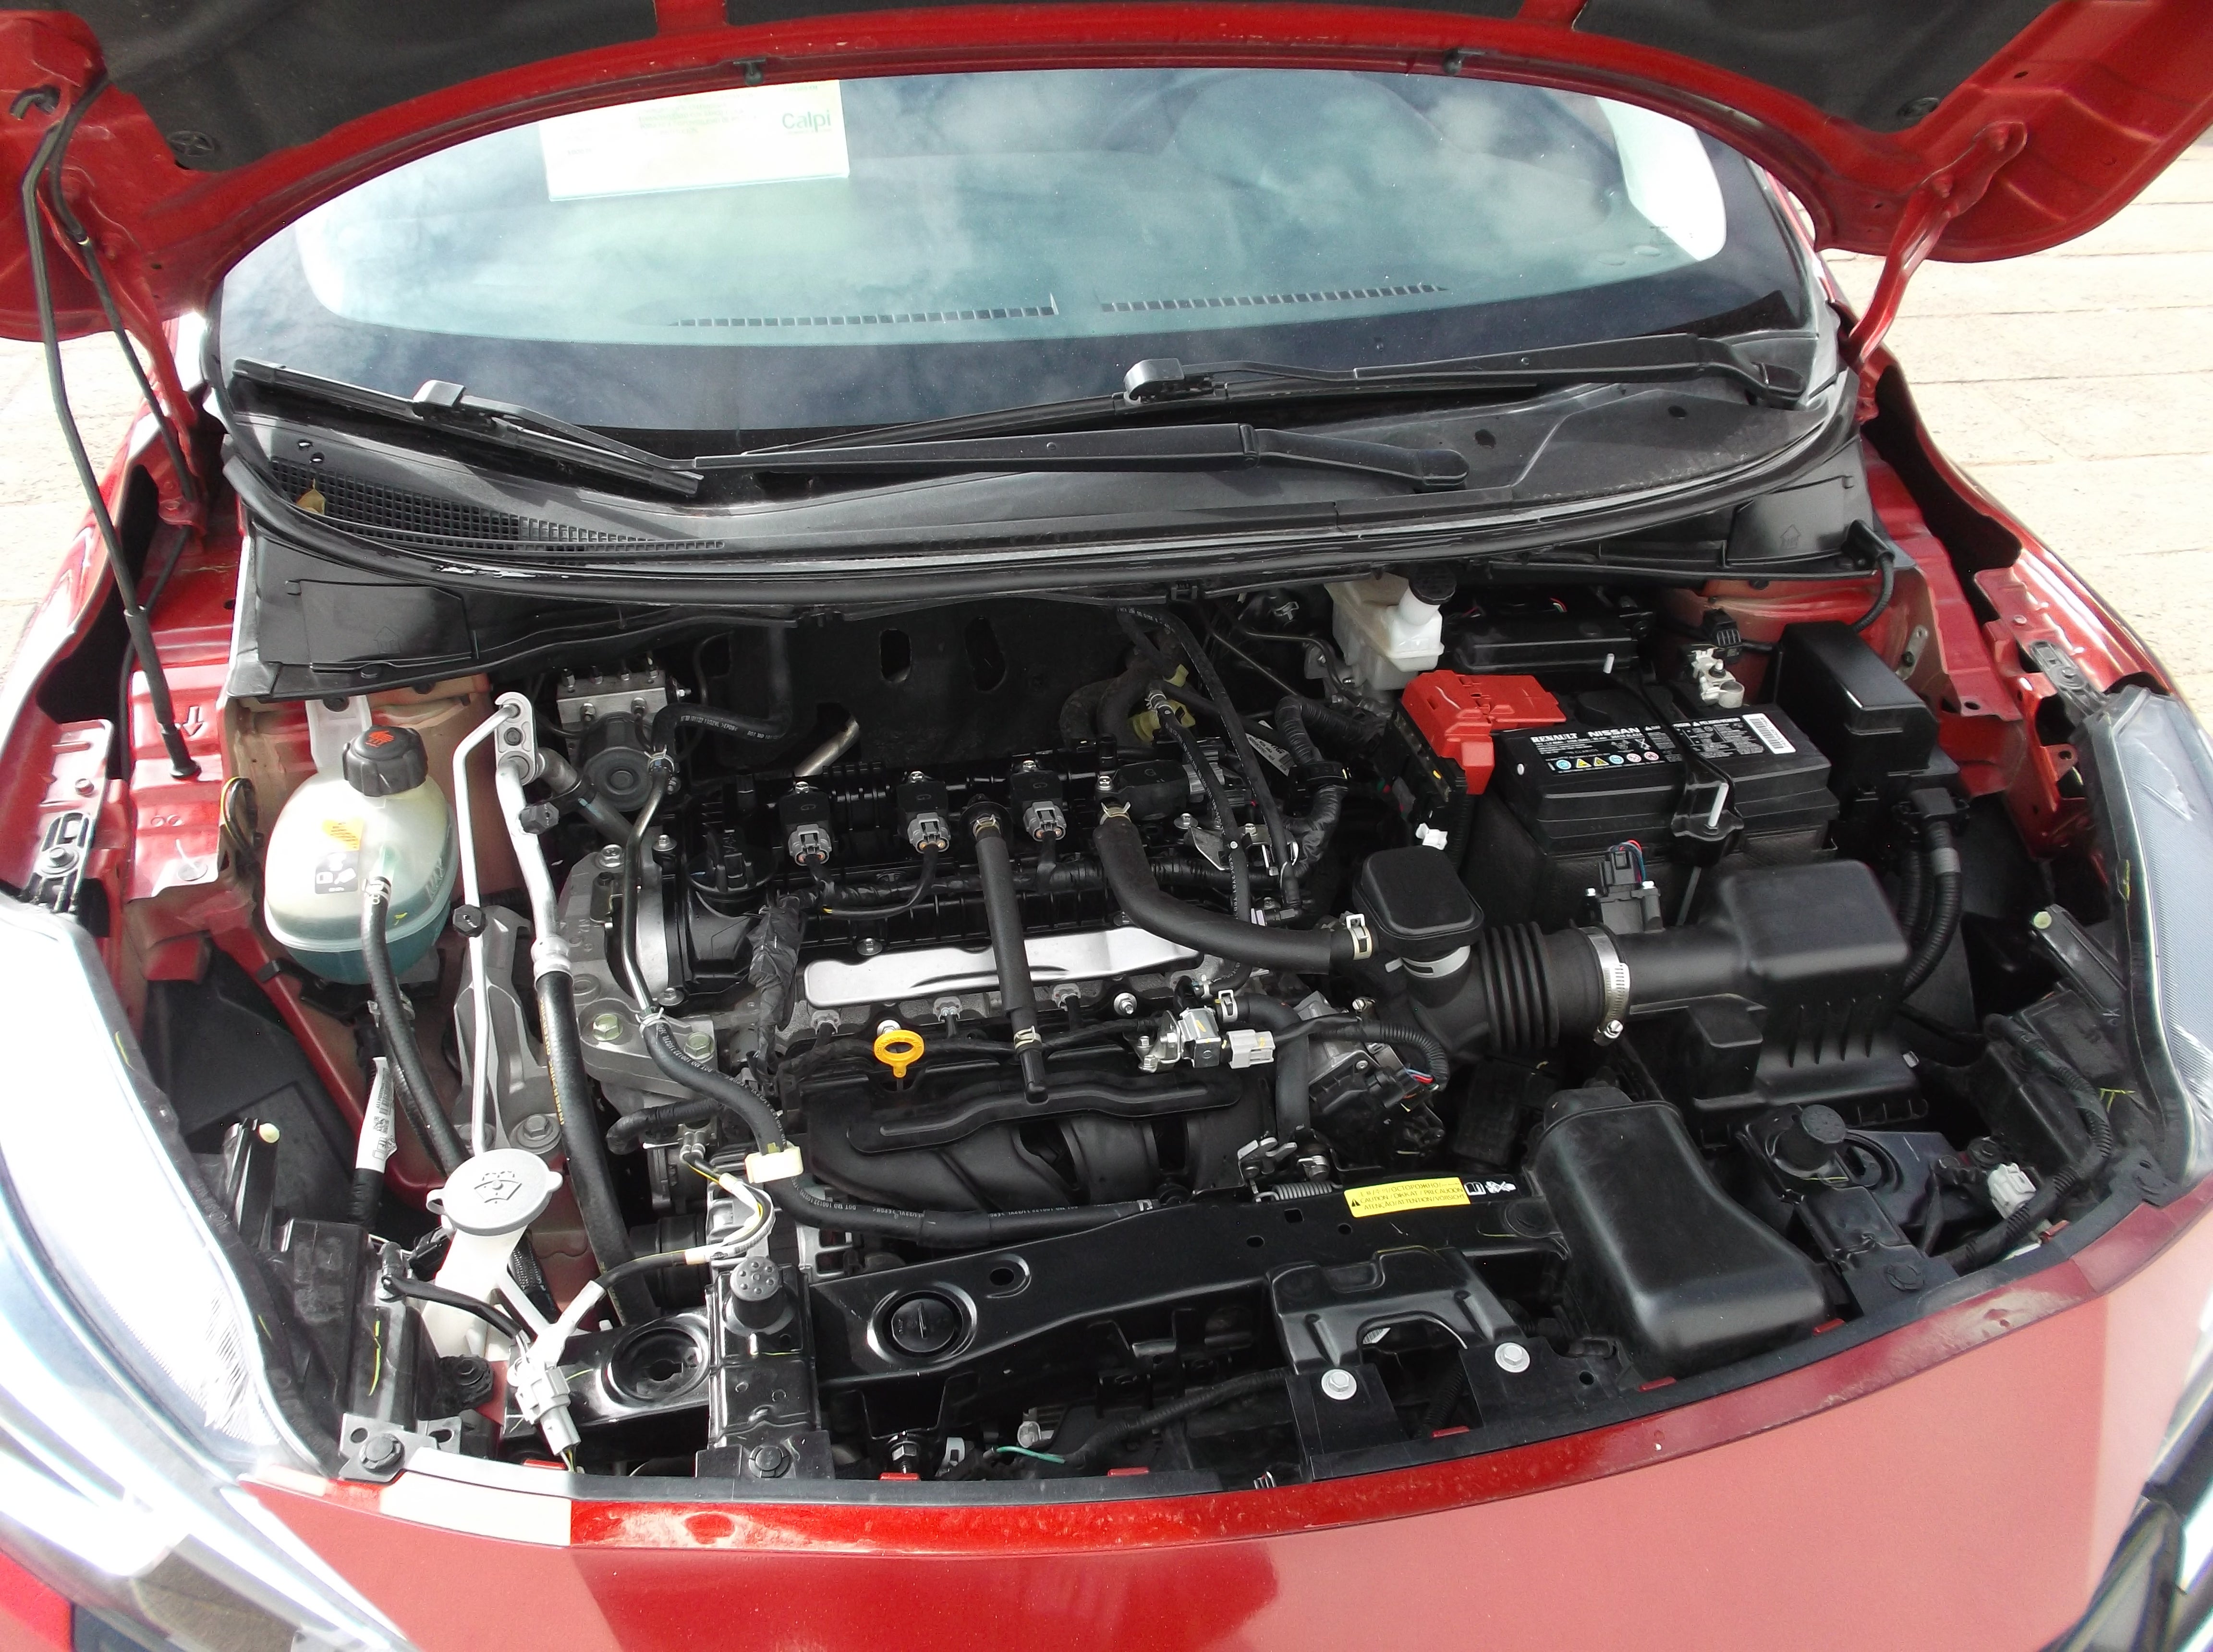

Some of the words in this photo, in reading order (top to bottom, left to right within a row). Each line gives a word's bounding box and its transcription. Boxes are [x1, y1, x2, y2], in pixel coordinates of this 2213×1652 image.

[782, 109, 831, 133] Calpi
[1531, 733, 1578, 743] RENAULT
[1588, 727, 1641, 738] NISSAN
[1360, 1194, 1389, 1204] CAUTION
